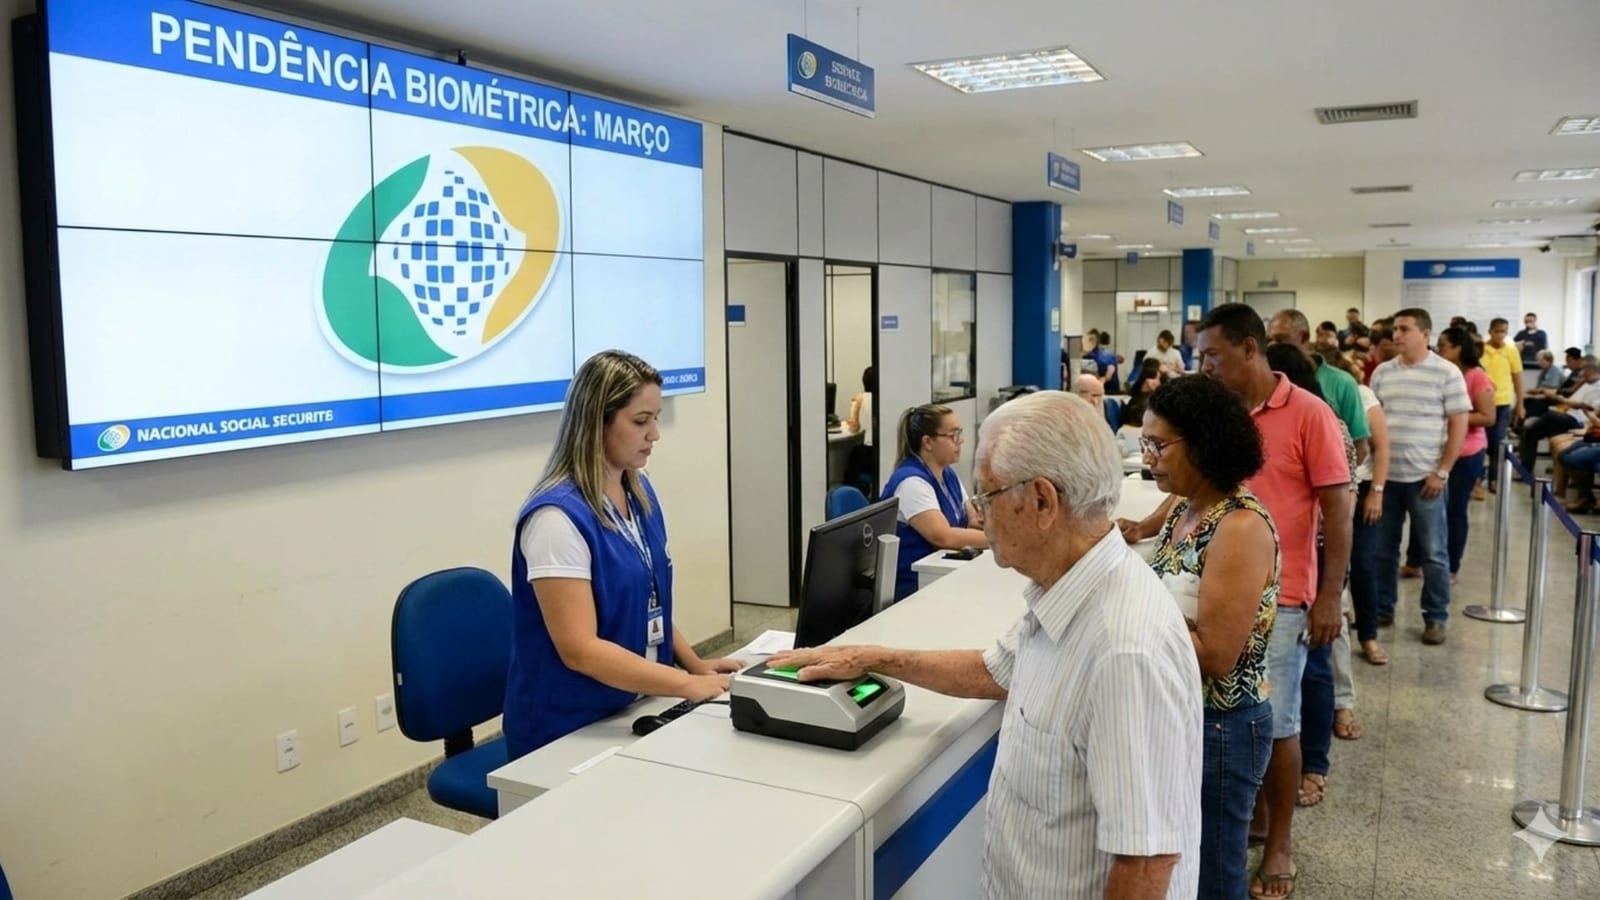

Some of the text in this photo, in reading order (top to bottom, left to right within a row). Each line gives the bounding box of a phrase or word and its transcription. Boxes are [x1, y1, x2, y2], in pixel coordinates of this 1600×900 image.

[151, 12, 670, 155] PENDÊNCIA BIOMÉTRICA: MARÇO
[137, 422, 217, 442] NACIONAL
[220, 417, 270, 433] SOCIAL
